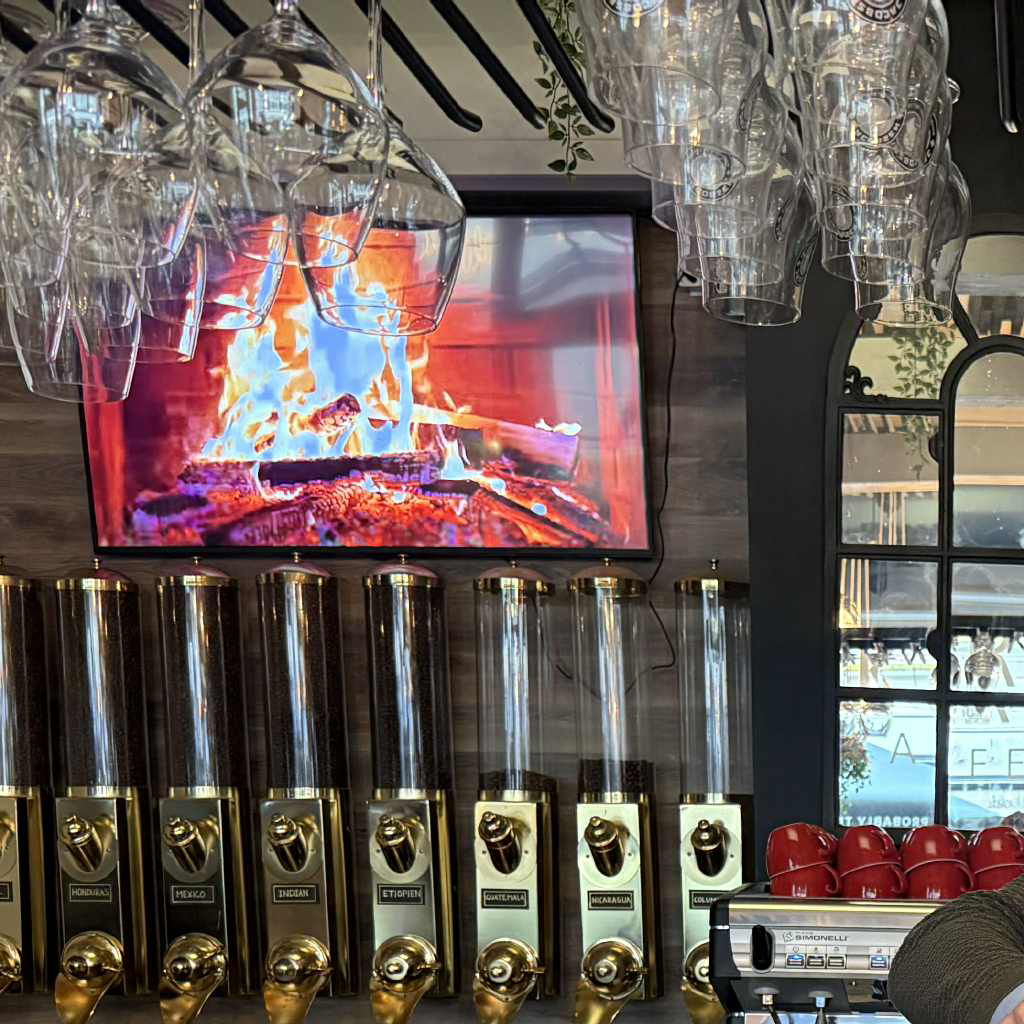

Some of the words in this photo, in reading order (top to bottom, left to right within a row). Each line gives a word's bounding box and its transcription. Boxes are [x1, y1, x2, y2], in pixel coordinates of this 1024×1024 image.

[175, 889, 206, 899] MEXICO
[278, 889, 309, 898] INDIAN
[382, 889, 421, 898] ETIOPIEN
[591, 896, 631, 904] NICARAGUA
